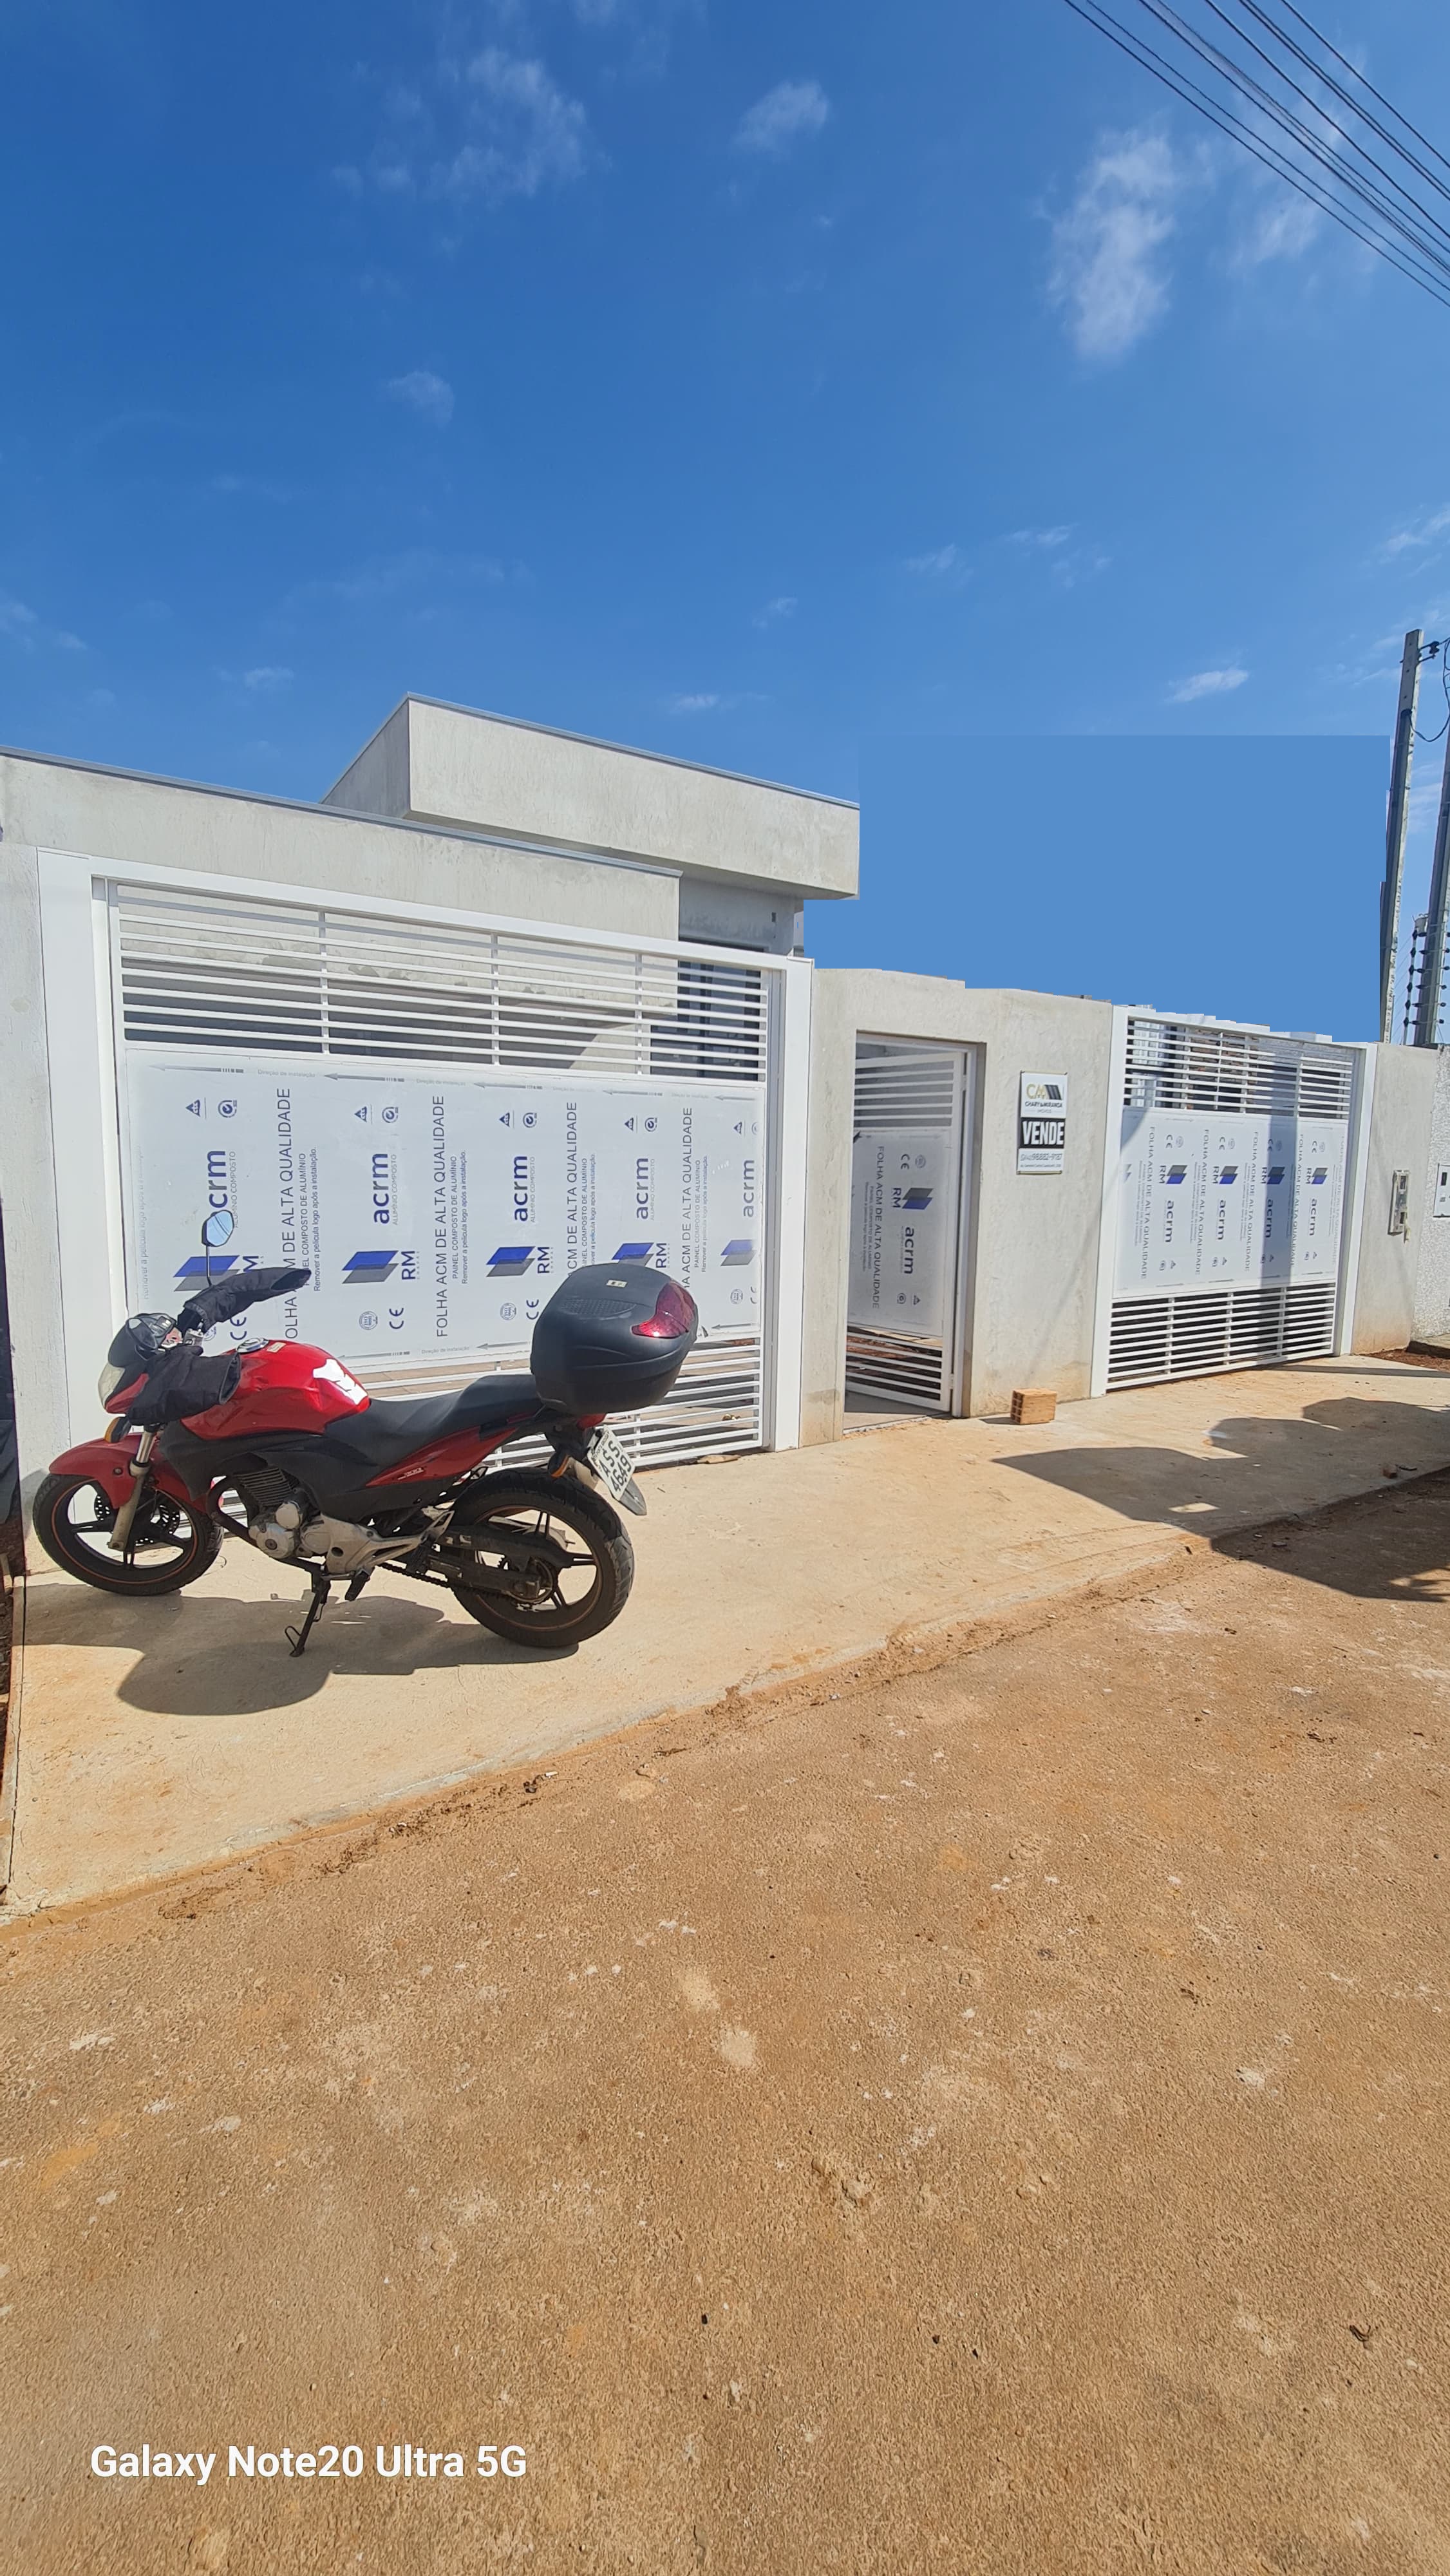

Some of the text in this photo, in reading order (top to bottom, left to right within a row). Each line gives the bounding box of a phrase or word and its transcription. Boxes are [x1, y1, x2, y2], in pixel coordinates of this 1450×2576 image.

[277, 1088, 293, 1182] QUALIDADE
[683, 1107, 692, 1183] QUALIDADE
[1022, 1121, 1064, 1145] VENDE
[207, 1150, 228, 1209] crm
[372, 1153, 390, 1224] acrm
[513, 1156, 528, 1222] acrm
[567, 1102, 578, 1273] CM DE ALTA QUALIDADE
[636, 1158, 648, 1219] acrm
[743, 1159, 755, 1218] acrm
[1159, 1164, 1167, 1184] RM
[1212, 1166, 1219, 1184] RM
[1260, 1166, 1268, 1184] RM
[1305, 1168, 1312, 1184] RM
[281, 1186, 295, 1227] ALTA
[300, 1195, 307, 1206] DE
[310, 1191, 320, 1208] após
[451, 1195, 458, 1205] DE
[460, 1191, 468, 1207] após
[581, 1194, 587, 1204] DE
[682, 1186, 692, 1219] ALTA
[892, 1188, 902, 1208] RM
[311, 1210, 321, 1225] logo
[433, 1095, 448, 1337] FOLHA ACM DE ALTA QUALIDADE
[460, 1208, 468, 1222] logo
[875, 1208, 882, 1222] DE
[1165, 1200, 1174, 1243] acrm
[1217, 1200, 1226, 1240] acrm
[1265, 1198, 1274, 1238] acrm
[1309, 1198, 1317, 1236] acrm
[282, 1231, 296, 1253] DE
[300, 1208, 309, 1255] COMPOSTO
[682, 1224, 691, 1240] DE
[243, 1256, 259, 1273] M
[401, 1251, 416, 1280] RM
[537, 1246, 550, 1274] RM
[655, 1242, 667, 1268] RM
[682, 1244, 691, 1273] ACM
[903, 1226, 914, 1274] acrm
[872, 1251, 881, 1309] QUALIDADE
[285, 1296, 298, 1339] OLHA
[599, 1440, 619, 1477] ASS
[610, 1455, 632, 1492] 4649
